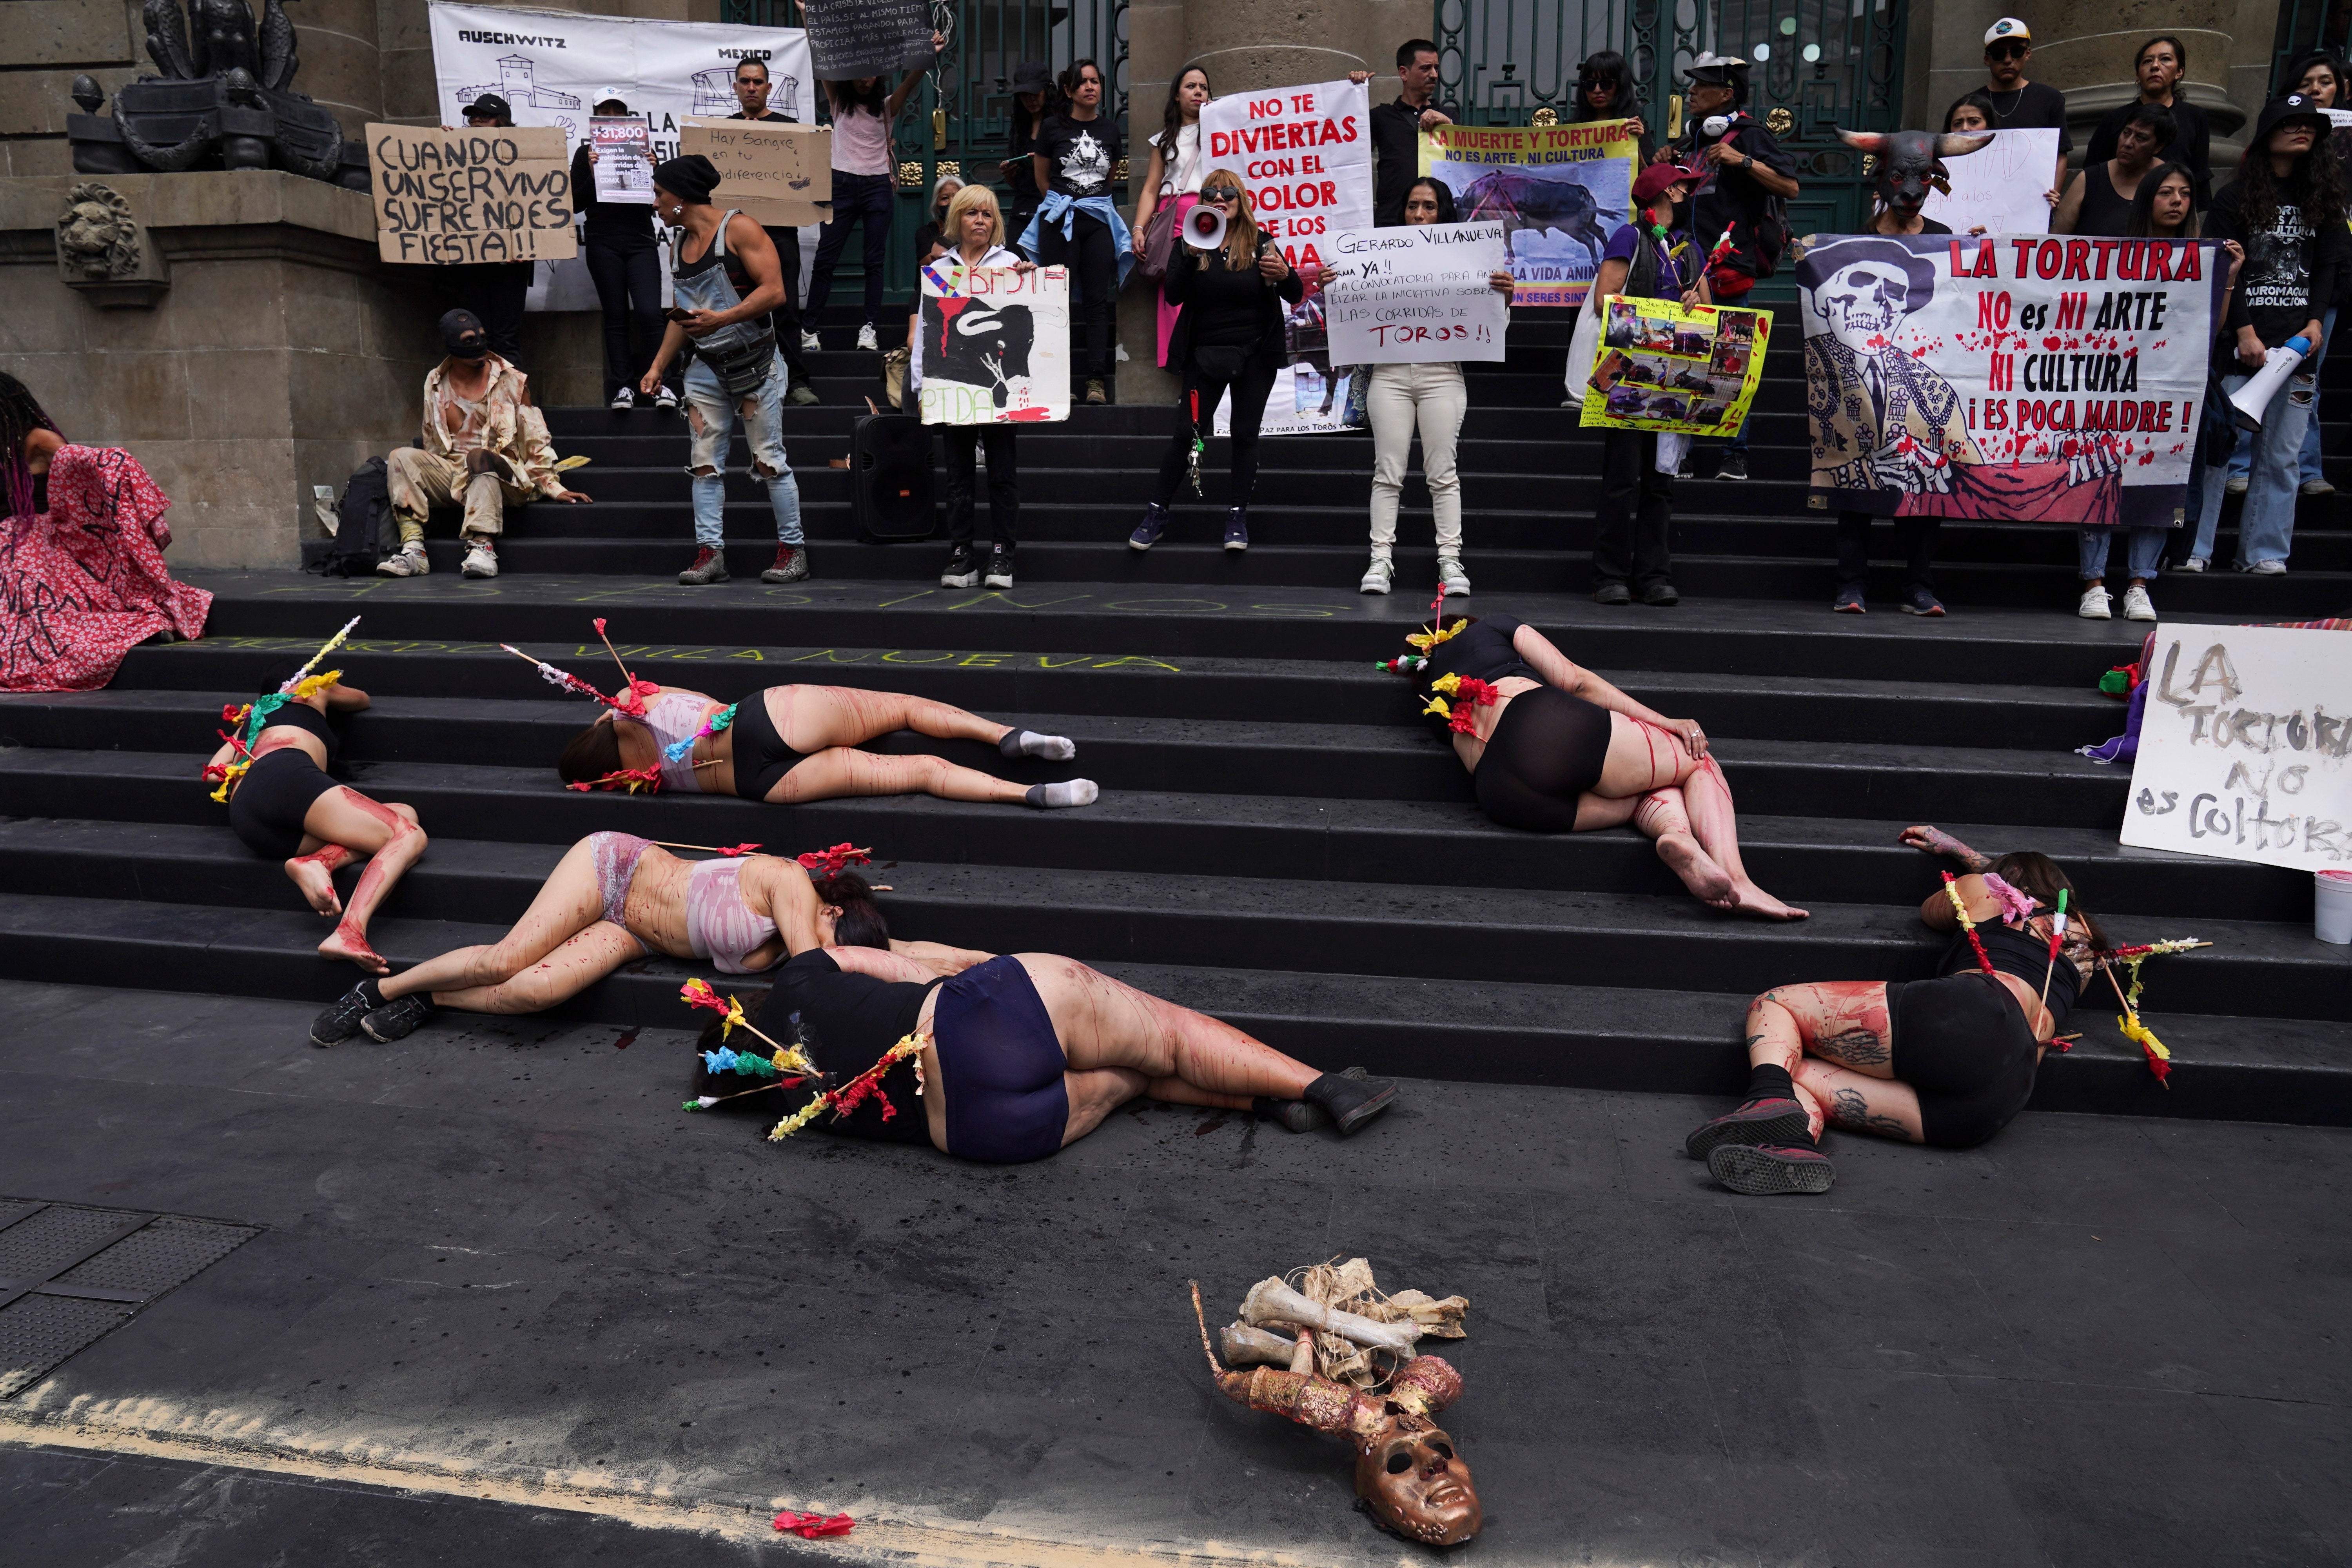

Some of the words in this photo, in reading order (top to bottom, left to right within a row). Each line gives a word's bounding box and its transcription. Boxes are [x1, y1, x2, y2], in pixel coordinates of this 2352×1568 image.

[818, 3, 828, 13] LA
[830, 0, 853, 10] CRISIS
[872, 7, 898, 18] MISMO
[809, 26, 850, 36] ESTAMOS
[897, 17, 920, 27] PARA
[458, 30, 567, 49] AUSCHWITZ
[810, 36, 856, 48] PROPICIAR
[861, 33, 880, 43] MÁS
[882, 27, 935, 40] VIOLENCIA
[718, 48, 772, 62] MEXICO
[817, 52, 826, 62] Si
[1249, 98, 1282, 120] NO
[1291, 94, 1314, 114] TE
[592, 127, 644, 140] +31,800
[711, 131, 736, 145] Hay
[743, 132, 794, 151] Sangre
[1211, 116, 1357, 158] DIVIERTAS
[1429, 129, 1449, 147] LA
[1454, 131, 1524, 149] MUERTE
[1528, 132, 1541, 149] Y
[1545, 124, 1629, 148] TORTURA
[377, 135, 518, 171] CUANDO
[738, 150, 752, 160] tu
[1445, 149, 1462, 163] NO
[1466, 151, 1481, 162] ES
[1484, 152, 1517, 164] ARTE
[1528, 152, 1541, 164] NI
[1544, 147, 1605, 163] CULTURA
[718, 169, 793, 180] ndiferencia
[1247, 158, 1294, 180] CON
[1301, 155, 1325, 174] EL
[383, 170, 426, 200] UN
[428, 166, 495, 203] SER
[494, 167, 568, 197] VIVO
[1066, 182, 1077, 192] LOVE
[383, 198, 478, 234] SUFRE
[483, 201, 524, 230] NO
[528, 198, 571, 229] ES
[1287, 216, 1326, 237] LOS
[2264, 225, 2316, 237] CULTURA
[399, 230, 537, 265] FIESTA!!
[1336, 232, 1414, 255] GERARDO
[1418, 227, 1504, 245] VILLANUEVA:
[1949, 238, 1998, 279] LA
[2011, 237, 2202, 283] TORTURA
[1361, 261, 1379, 279] YA
[1531, 267, 1562, 281] VIDA
[1565, 265, 1600, 281] ANIM
[1333, 281, 1348, 293] LA
[1350, 273, 1434, 292] CONVOCATORIA
[1440, 270, 1470, 282] PARA
[2245, 285, 2309, 297] AUROMAQUIA
[1330, 293, 1368, 306] LIZAR
[1375, 291, 1387, 301] LA
[1392, 287, 1450, 299] INICIATIVA
[1455, 287, 1494, 296] SOBRE
[1526, 292, 1561, 303] SERES
[1564, 292, 1589, 303] SINT
[1645, 298, 1659, 307] Ser
[1663, 301, 1684, 310] Human
[1339, 308, 1371, 323] LAS
[1376, 305, 1444, 322] CORRIDAS
[1450, 307, 1469, 318] DE
[1638, 305, 1657, 314] Honra
[1977, 290, 2012, 333] NO
[2020, 303, 2049, 332] es
[2054, 291, 2089, 331] NI
[2092, 291, 2168, 332] ARTE
[1367, 324, 1469, 348] TOROS
[1989, 353, 2014, 392] NI
[2023, 354, 2139, 393] CULTURA
[2274, 361, 2288, 374] Steren
[1983, 398, 2009, 430] ES
[2016, 399, 2076, 432] POCA
[2082, 399, 2173, 433] MADRE
[575, 645, 1181, 672] VILLANUEVA
[2156, 639, 2243, 710] LA
[2224, 757, 2311, 803] NO
